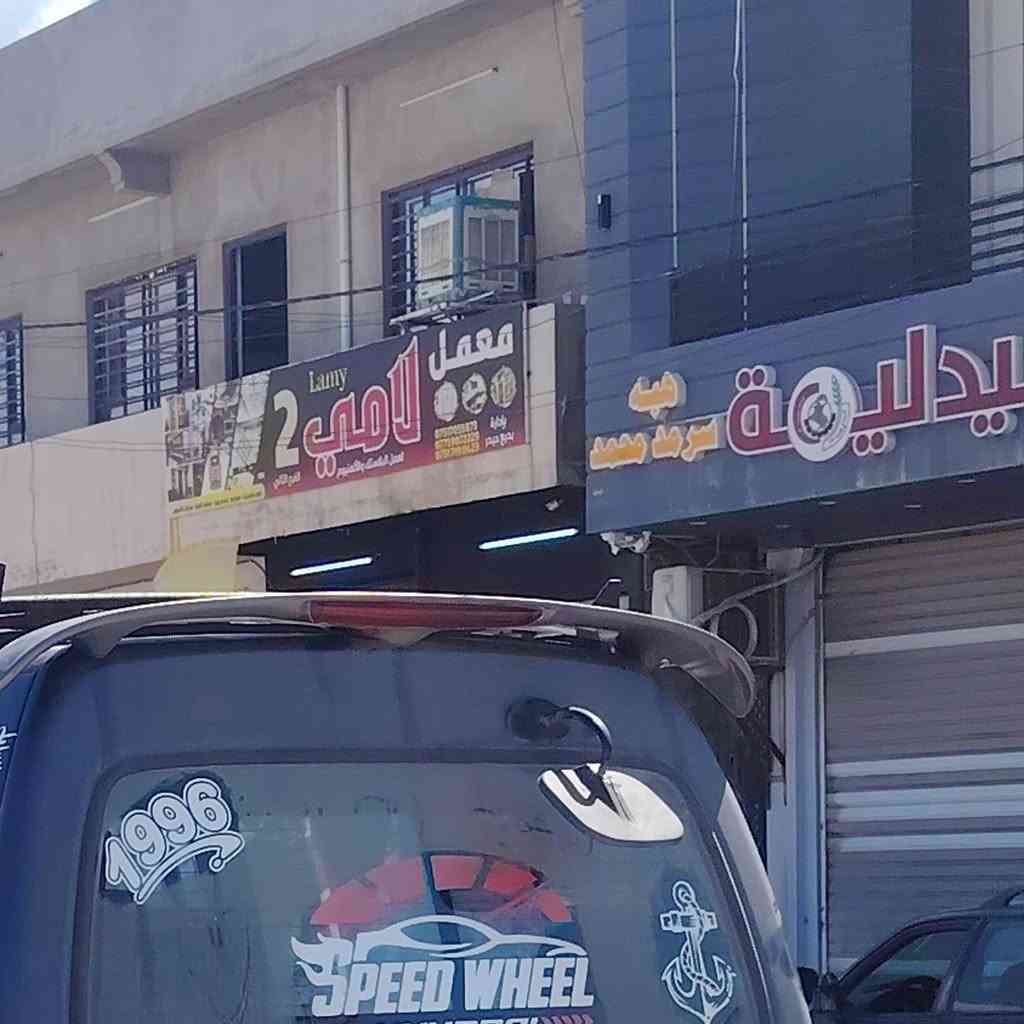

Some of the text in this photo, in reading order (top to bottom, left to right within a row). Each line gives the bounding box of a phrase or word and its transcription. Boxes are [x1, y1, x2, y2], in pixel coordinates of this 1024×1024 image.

[308, 367, 348, 393] Lamy
[428, 323, 513, 381] معمل
[273, 389, 300, 468] 2
[726, 324, 1024, 463] يدلية
[105, 777, 232, 893] 1996
[292, 936, 594, 1017] SPEED WHEEL
